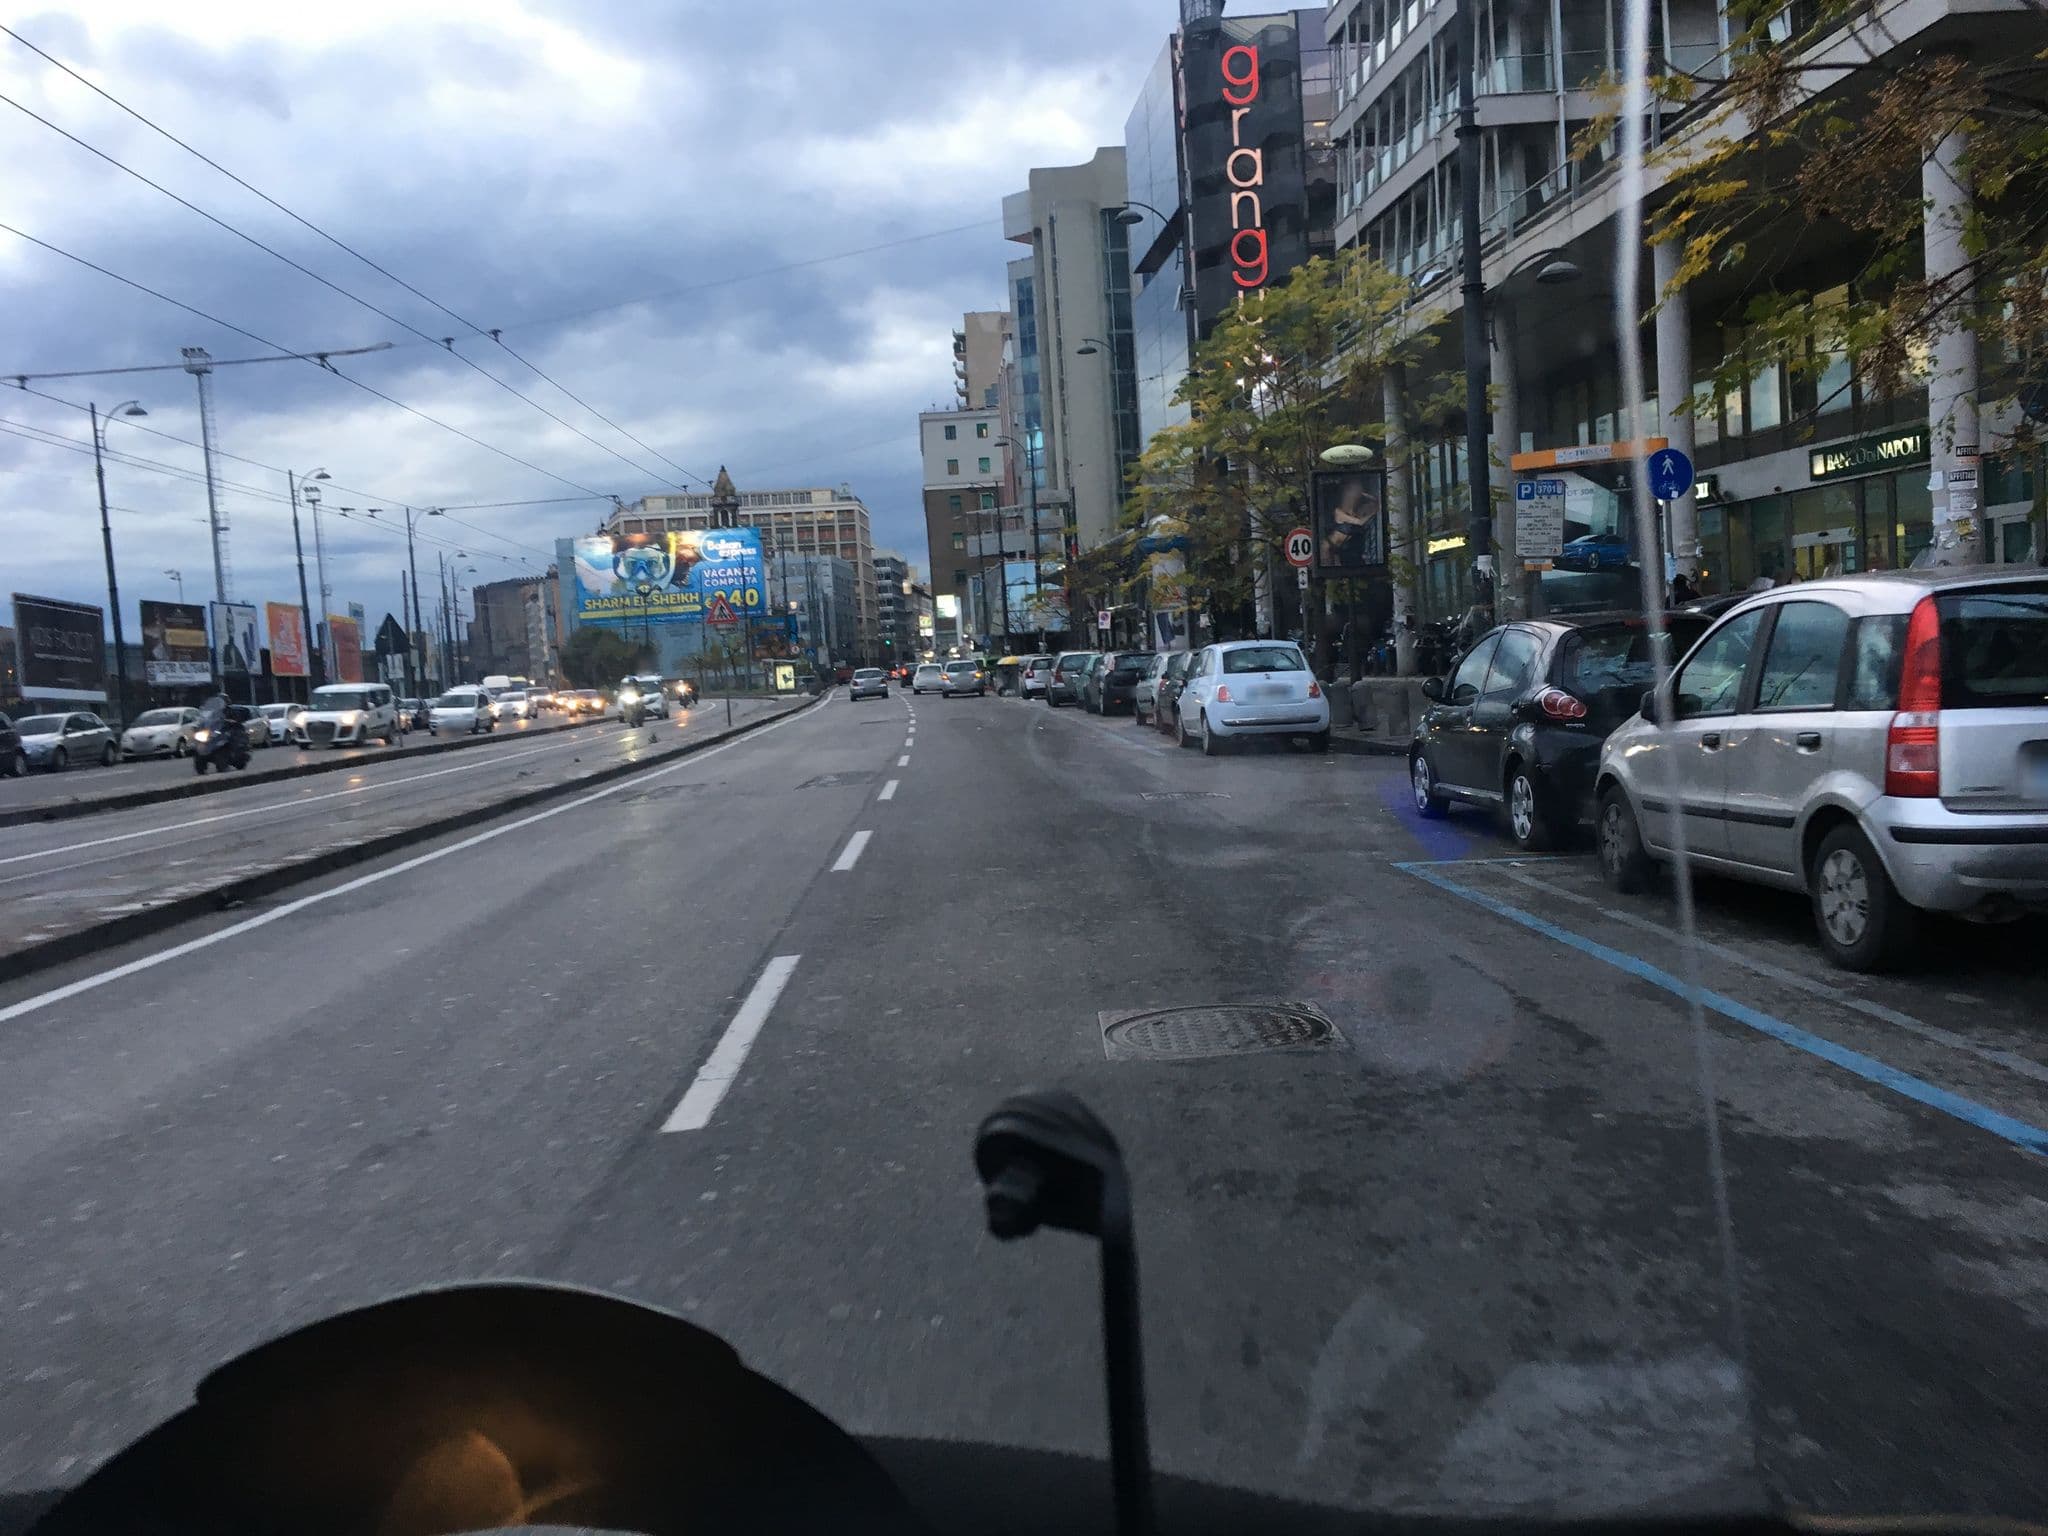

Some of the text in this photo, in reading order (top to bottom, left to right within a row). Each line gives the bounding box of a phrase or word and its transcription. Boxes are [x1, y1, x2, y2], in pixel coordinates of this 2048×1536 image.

[1876, 435, 1920, 459] NAPOLI
[1291, 538, 1312, 556] 40
[703, 566, 757, 578] VACANZA
[584, 596, 631, 610] SHARM
[652, 592, 700, 606] SHEIKH
